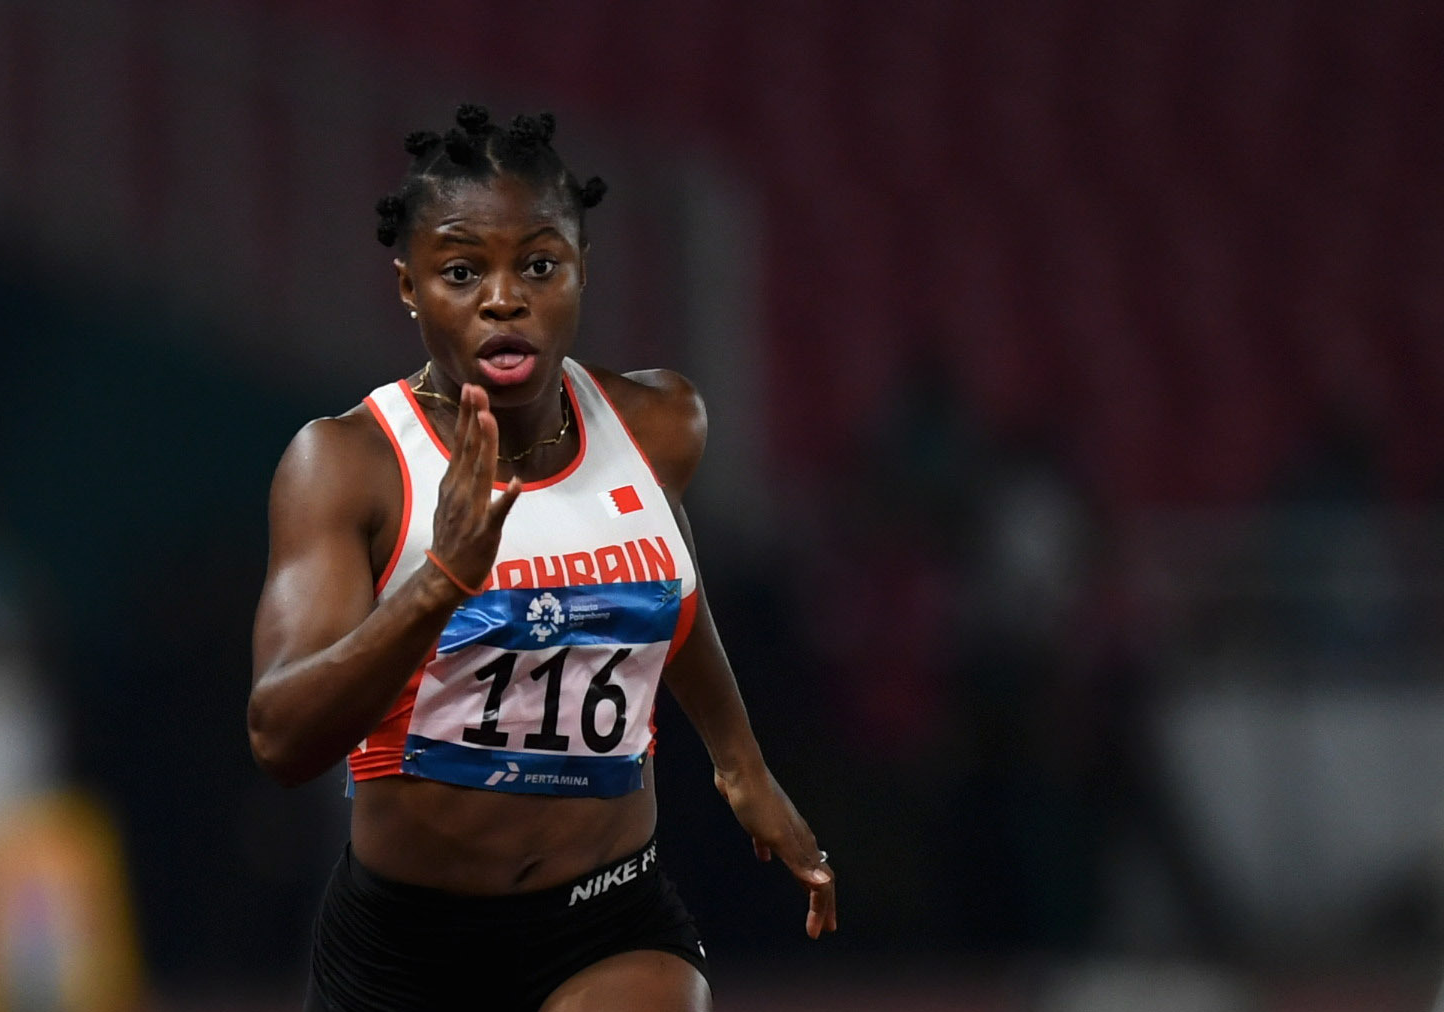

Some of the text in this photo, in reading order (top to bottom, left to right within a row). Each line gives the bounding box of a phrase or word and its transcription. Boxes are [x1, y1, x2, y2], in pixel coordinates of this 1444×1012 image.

[481, 536, 676, 590] AHRAIN
[462, 646, 633, 754] 116
[524, 773, 589, 786] PERTAMINA
[568, 858, 638, 906] NIKE
